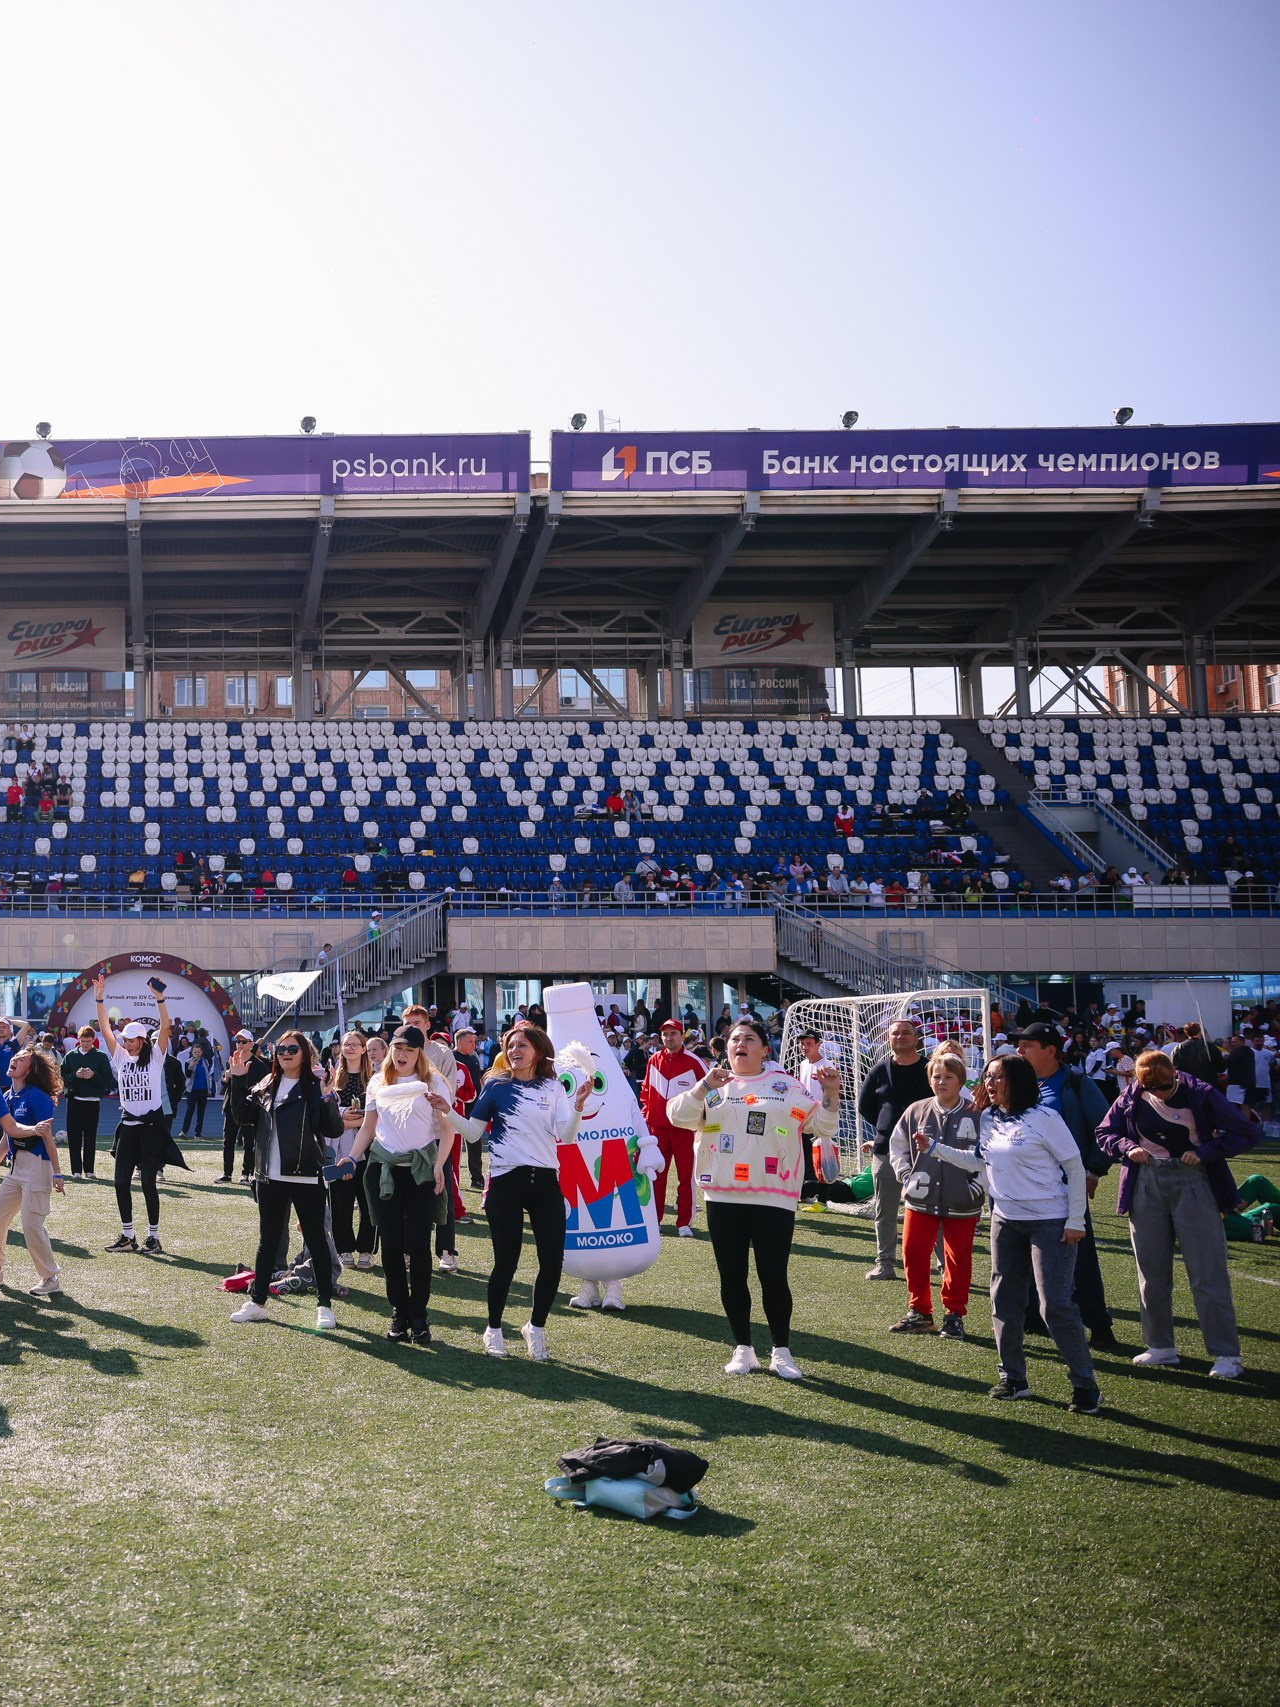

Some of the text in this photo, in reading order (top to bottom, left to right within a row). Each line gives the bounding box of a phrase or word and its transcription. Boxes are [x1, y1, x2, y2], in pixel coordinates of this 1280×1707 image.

[332, 452, 487, 484] psbank.ru
[645, 450, 712, 476] ПСБ
[762, 449, 1221, 477] Банк настоящих чемпионов
[50, 682, 88, 692] РОССИИ
[729, 679, 746, 688] №1
[759, 679, 799, 688] РОССИИ
[130, 955, 161, 963] КОМОС
[122, 1073, 150, 1087] YOUR
[906, 1171, 931, 1200] C
[576, 1232, 634, 1247] МОЛОКО
